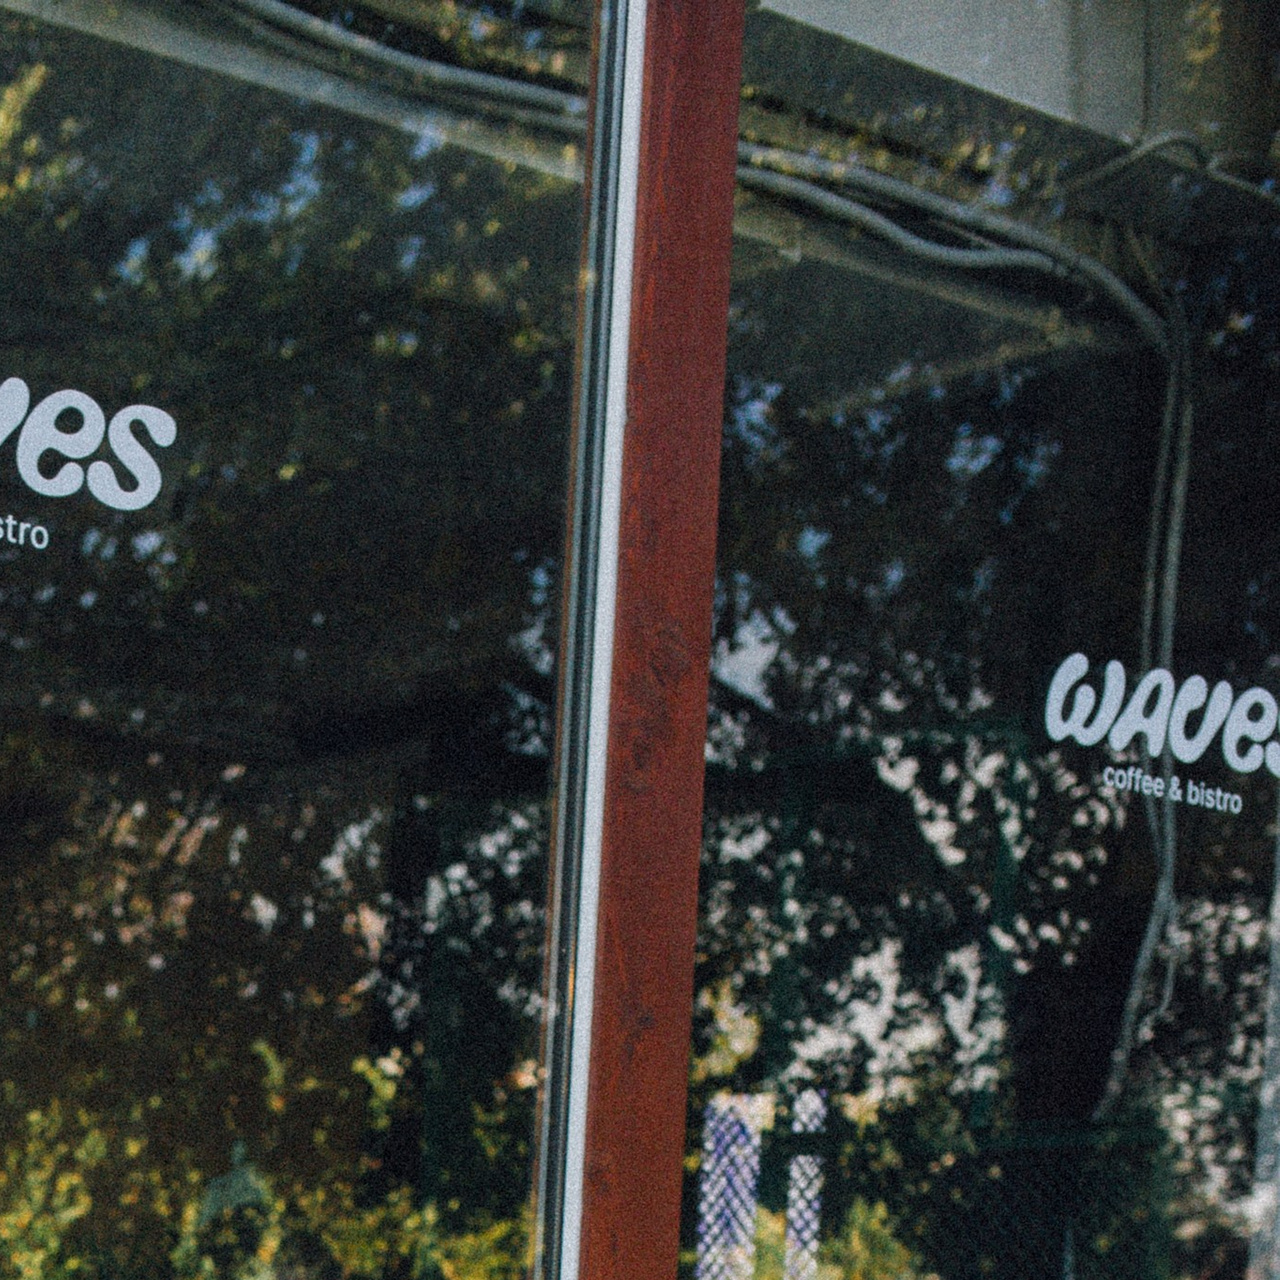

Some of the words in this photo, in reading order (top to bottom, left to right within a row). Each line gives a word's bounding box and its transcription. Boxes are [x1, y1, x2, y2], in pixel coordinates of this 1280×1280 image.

[1103, 766, 1165, 797] coffee
[1169, 776, 1182, 801] &
[1187, 780, 1243, 814] bistro
